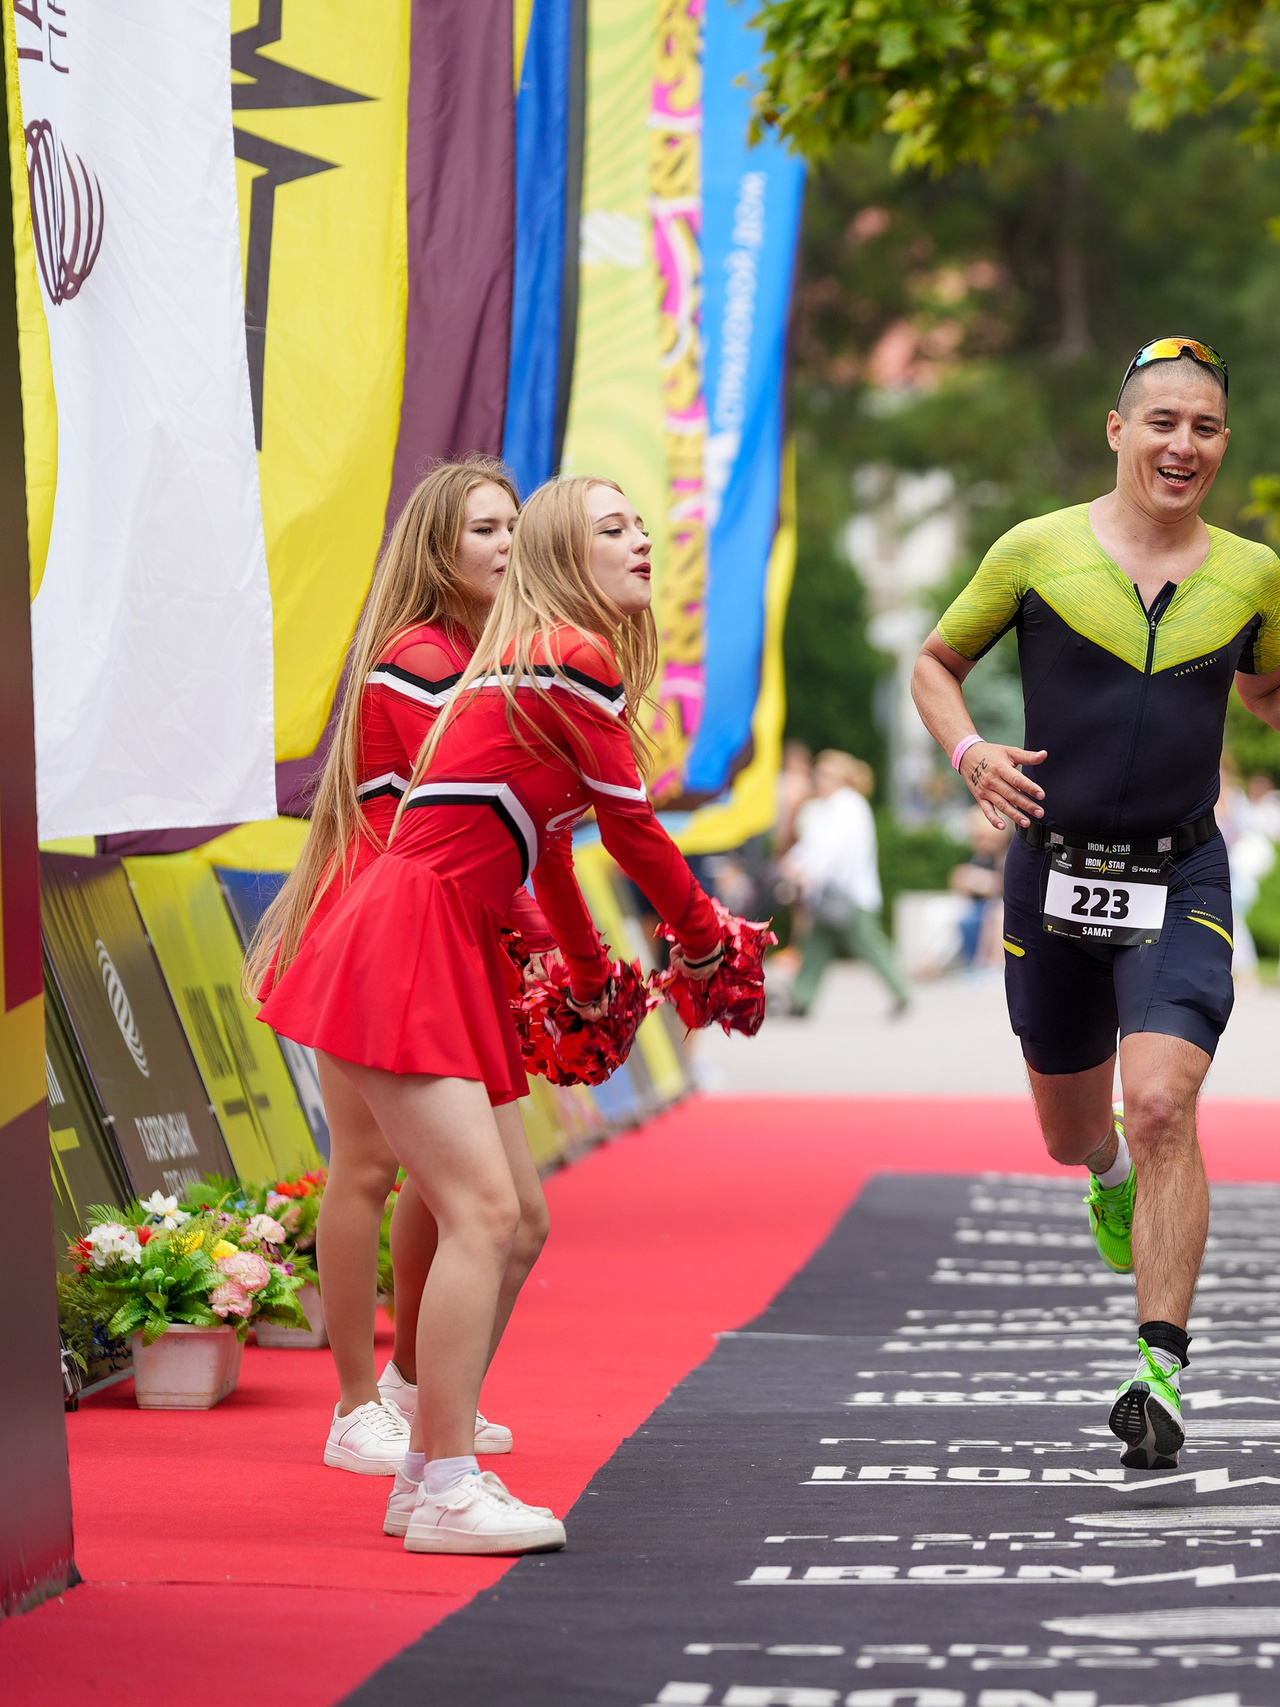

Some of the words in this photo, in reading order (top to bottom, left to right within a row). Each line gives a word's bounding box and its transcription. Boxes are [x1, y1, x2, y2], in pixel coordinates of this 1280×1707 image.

[1087, 842, 1104, 852] IRON
[1112, 843, 1130, 853] STAR
[1085, 857, 1102, 867] IRON
[1108, 860, 1125, 870] STAR
[1071, 885, 1130, 920] 223
[1082, 926, 1113, 938] SAMAT
[853, 1389, 1118, 1402] IRON
[810, 1465, 1125, 1481] IRON
[748, 1564, 1116, 1580] IRON
[656, 1681, 1098, 1707] IRON
